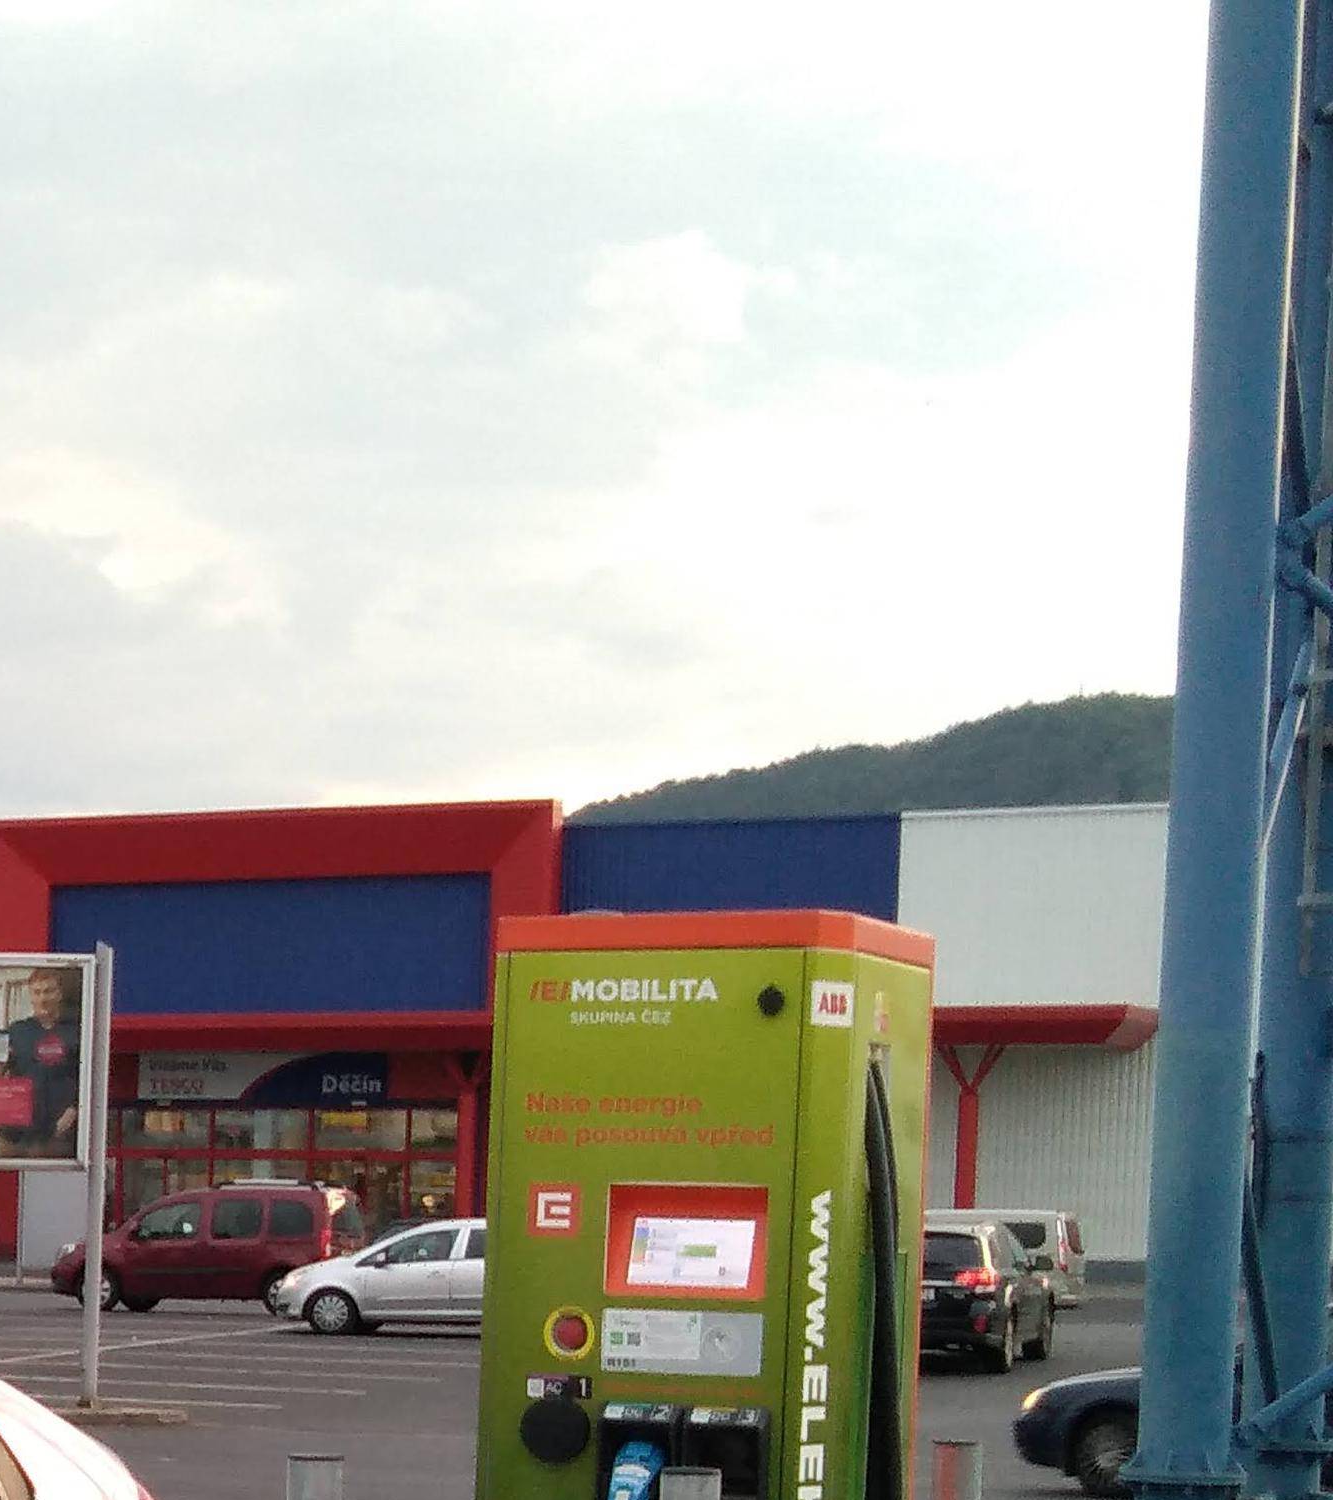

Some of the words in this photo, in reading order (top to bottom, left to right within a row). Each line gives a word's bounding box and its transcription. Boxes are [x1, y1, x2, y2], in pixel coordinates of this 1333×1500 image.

[818, 992, 849, 1016] ABB
[570, 1010, 636, 1027] SKUPINA
[321, 1072, 383, 1095] Děčín
[599, 1093, 703, 1118] energie
